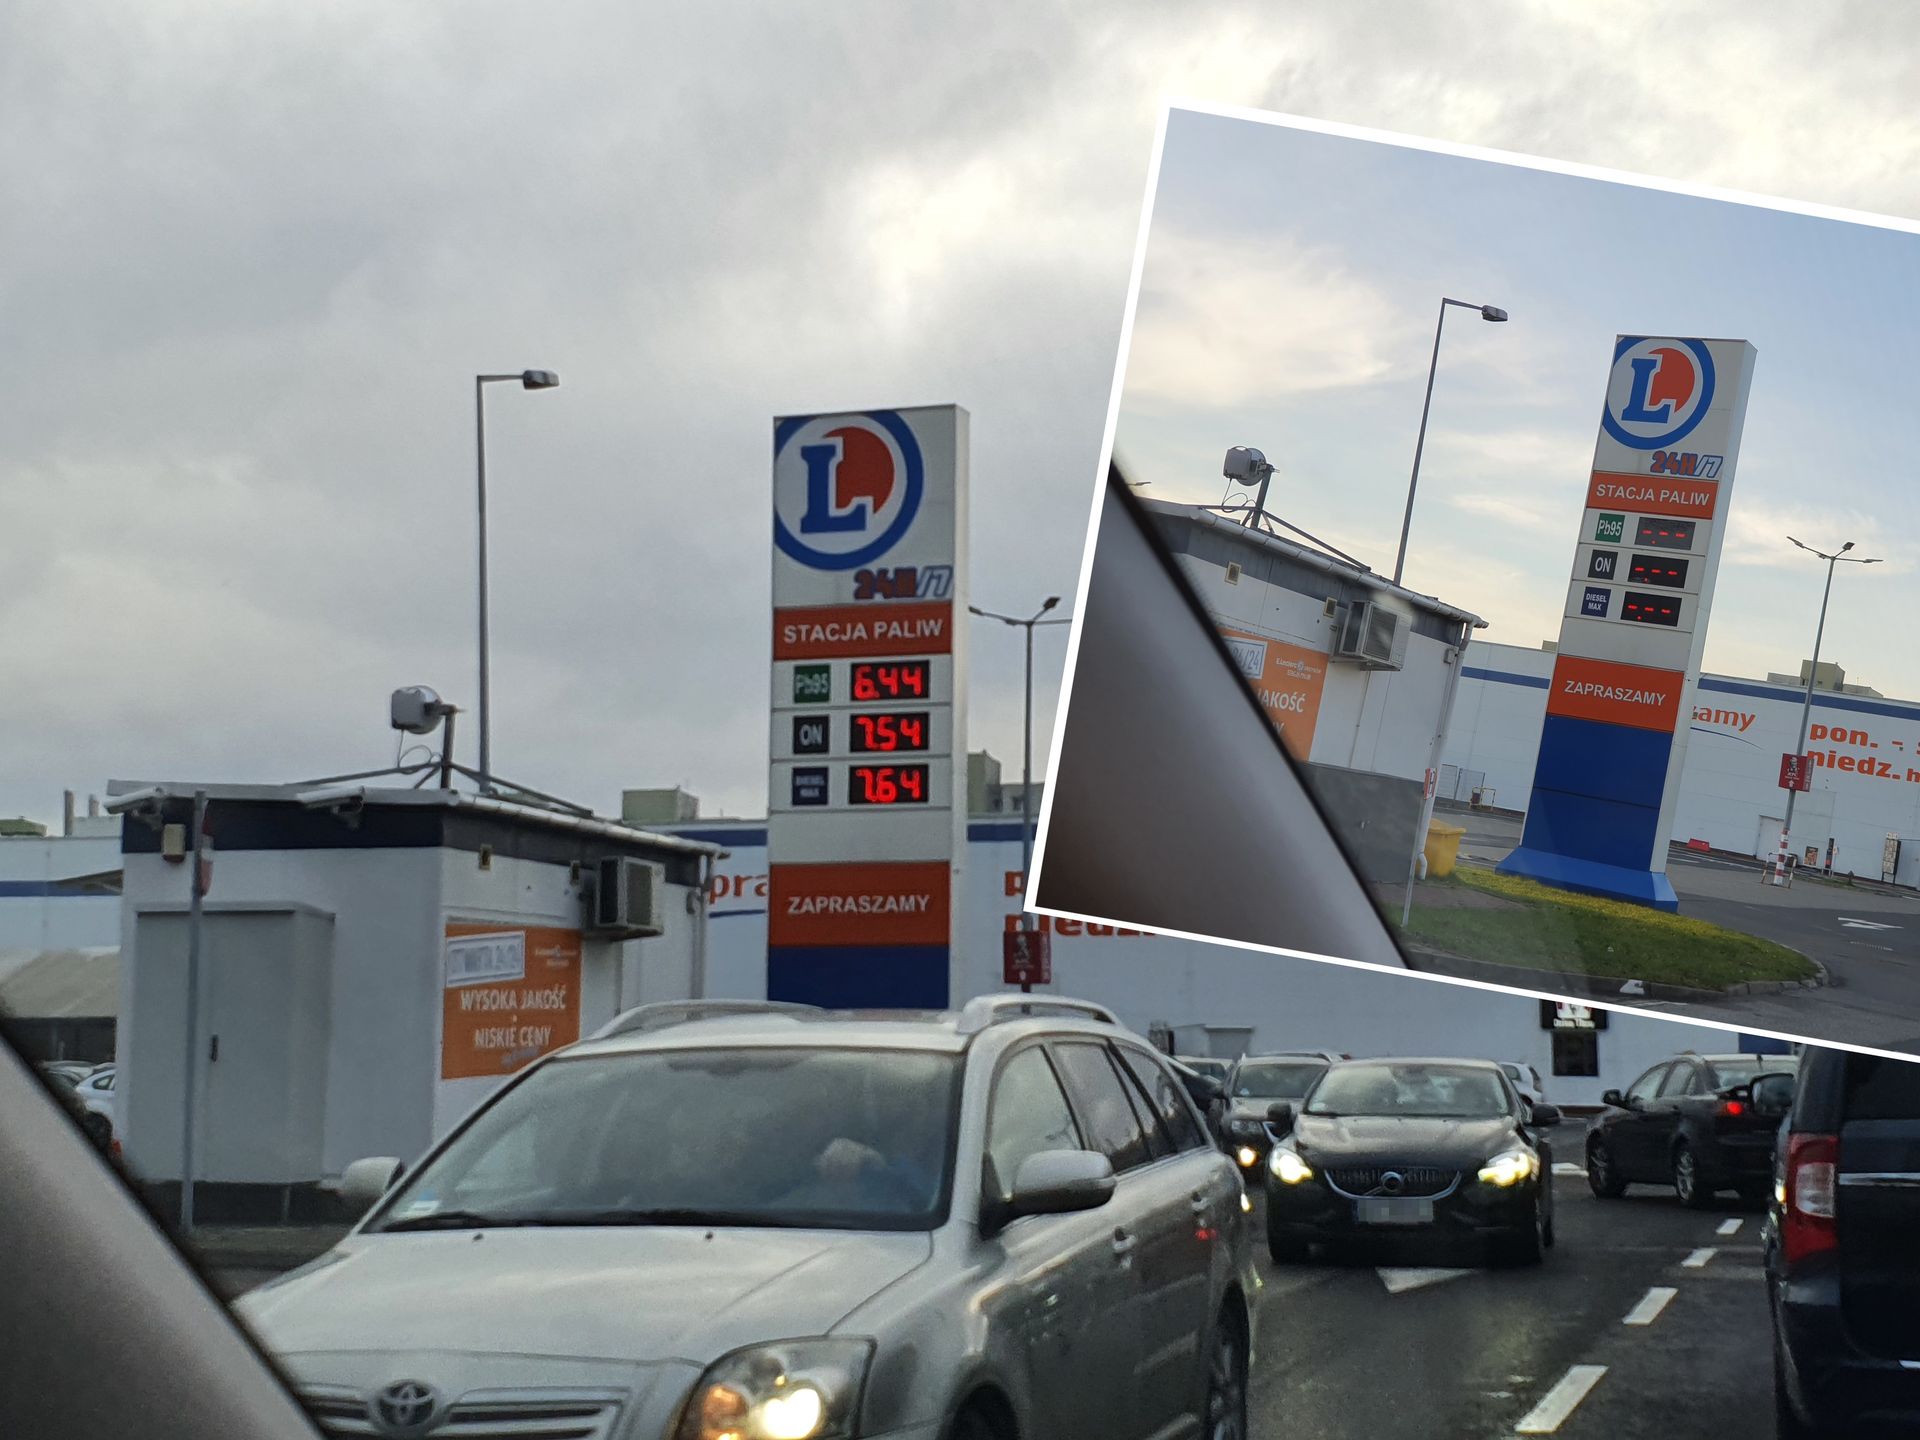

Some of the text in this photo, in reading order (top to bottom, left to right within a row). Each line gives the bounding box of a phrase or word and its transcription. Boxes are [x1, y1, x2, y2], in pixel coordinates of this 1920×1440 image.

[1596, 484, 1709, 506] STACJA PALIW
[1597, 519, 1622, 537] Pb95
[1594, 556, 1612, 573] ON
[1586, 593, 1607, 603] DIESEL
[1588, 602, 1602, 611] MAX
[783, 619, 943, 644] STACJA PALIW
[854, 665, 922, 700] 6.44
[1564, 680, 1666, 706] ZAPRASZAMY
[799, 723, 823, 746] ON
[1809, 723, 1879, 748] pon.
[1807, 750, 1901, 780] niedz.
[787, 894, 931, 915] ZAPRASZAMY
[460, 983, 566, 1010] WYSOKA JAKOŚĆ
[474, 1025, 552, 1049] NISKIE CENY
